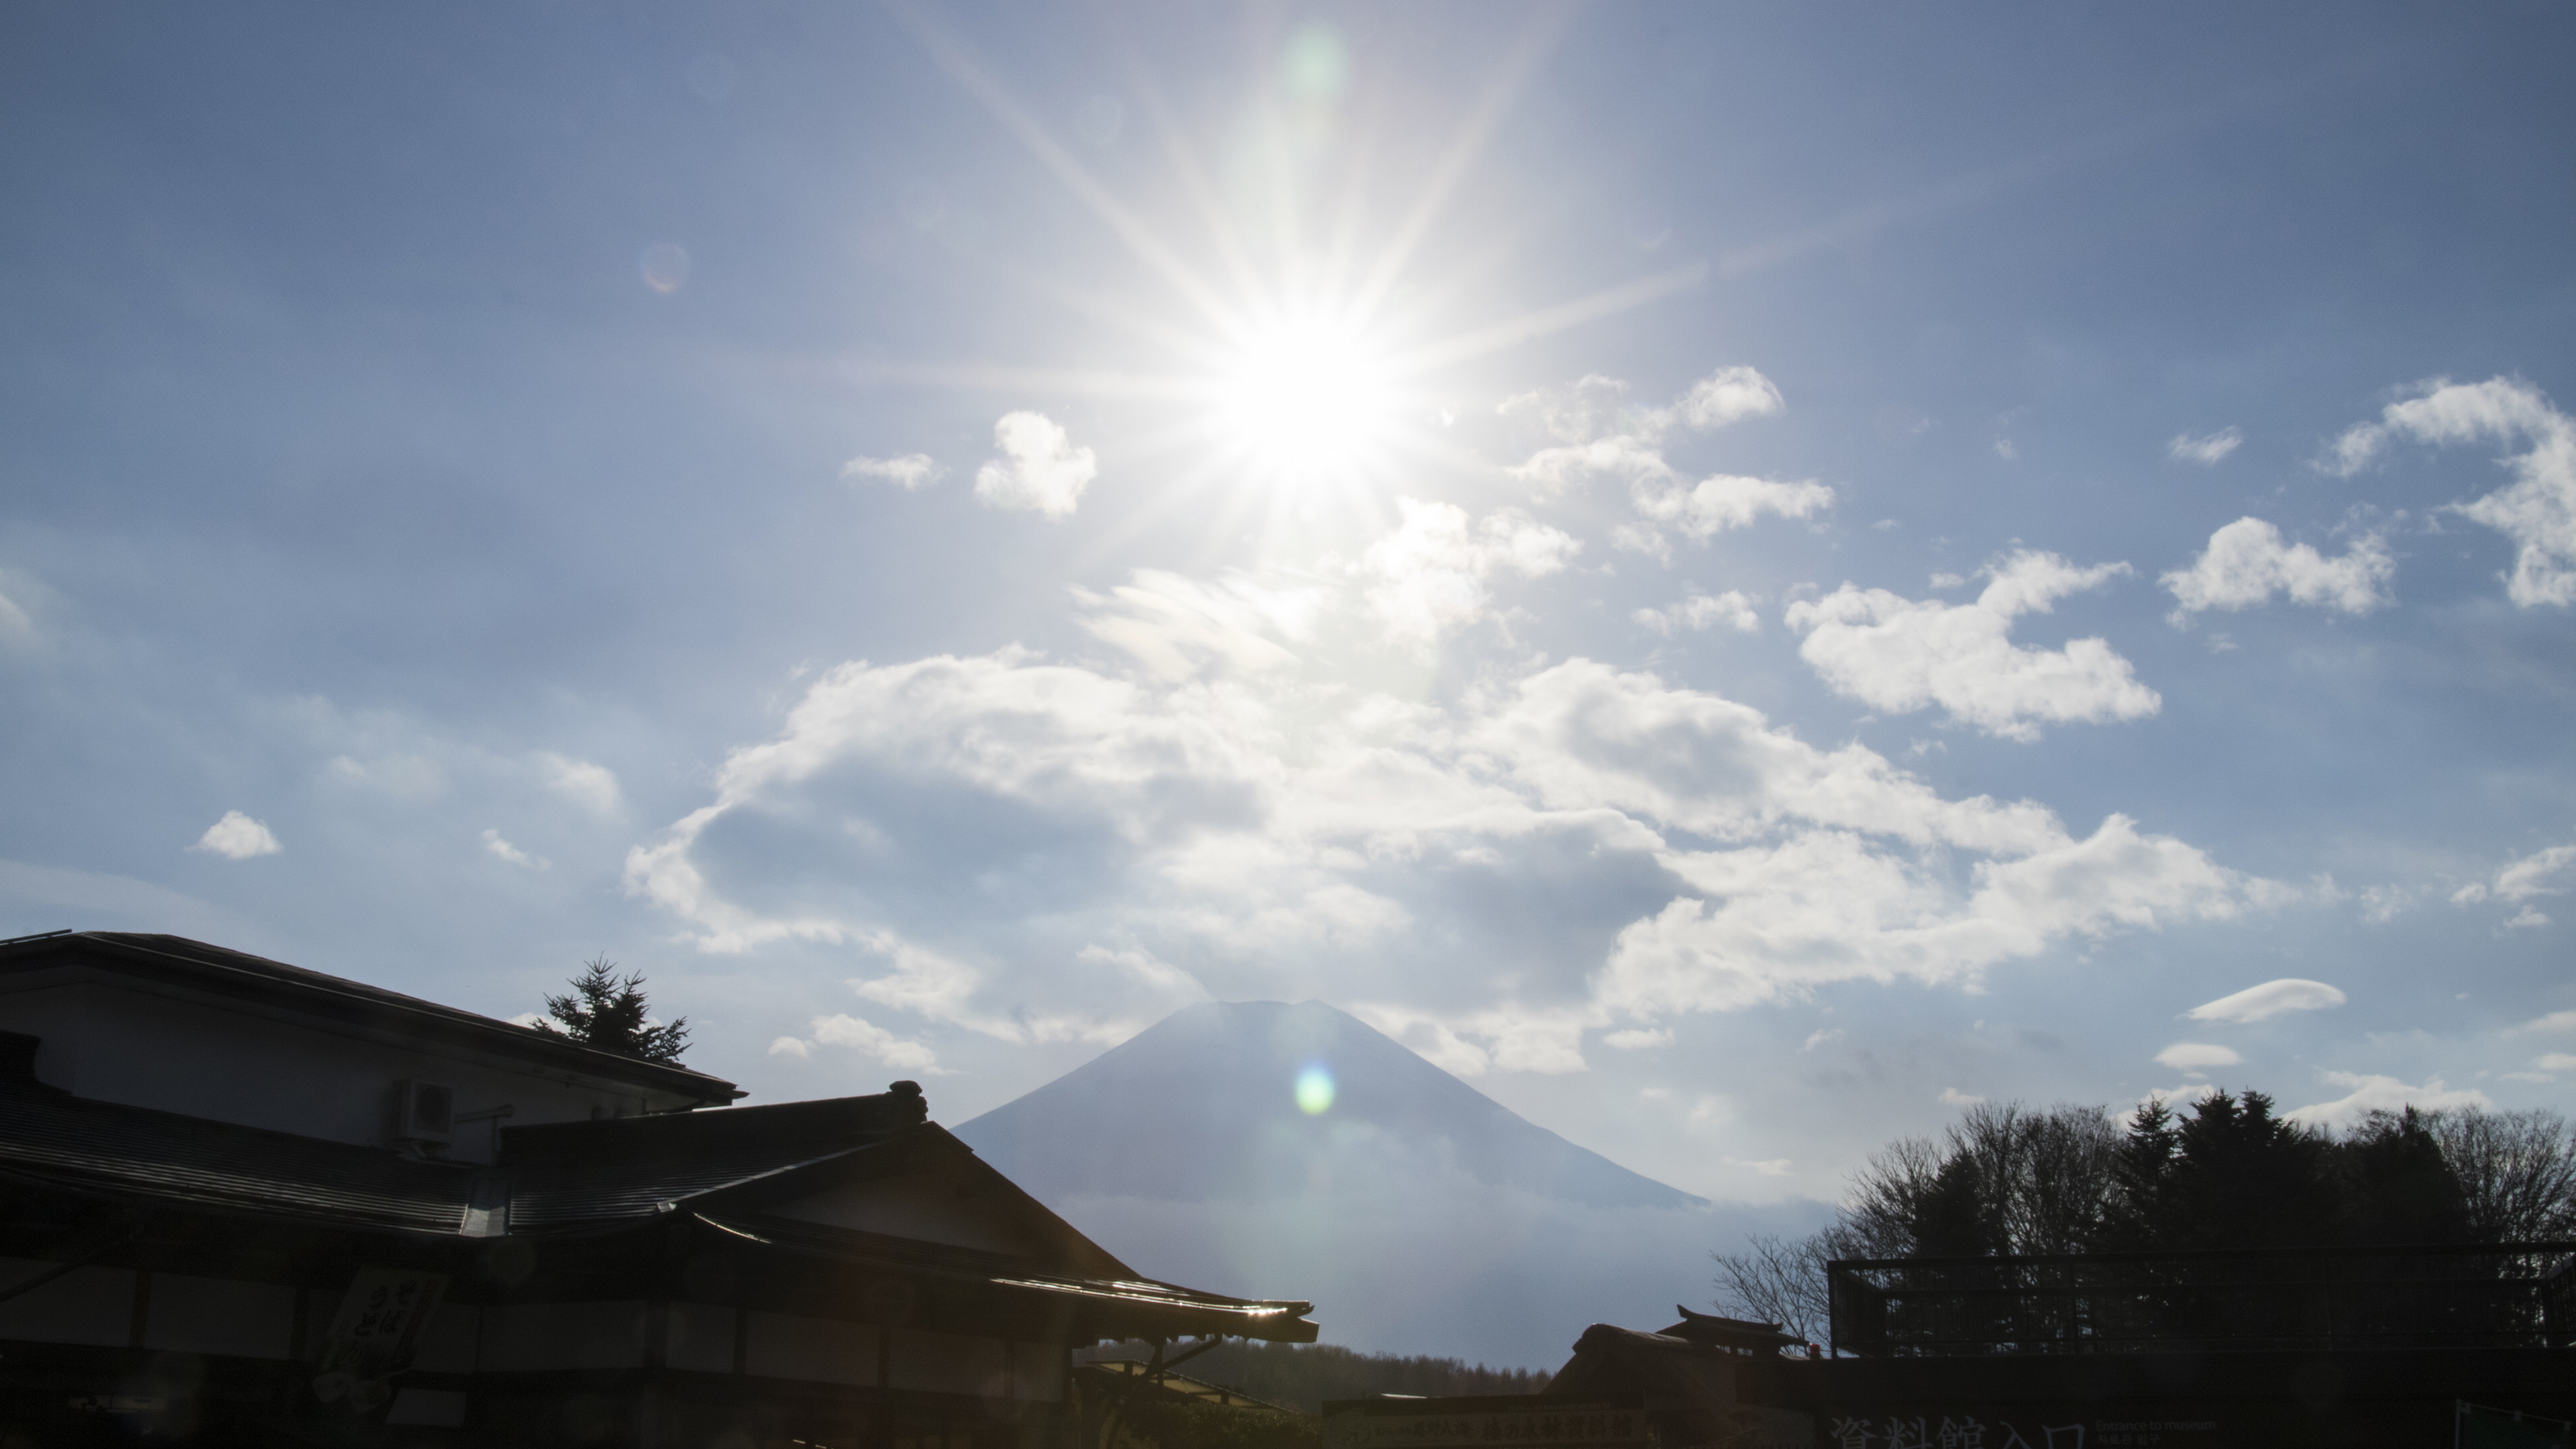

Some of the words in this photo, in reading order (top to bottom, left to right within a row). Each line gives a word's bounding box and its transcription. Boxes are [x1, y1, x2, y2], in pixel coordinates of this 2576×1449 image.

[379, 1279, 418, 1334] そば
[1830, 1415, 2086, 1449] 資料館入口
[2096, 1420, 2147, 1432] Entrance
[2149, 1421, 2162, 1431] to
[2164, 1421, 2217, 1430] museum
[2097, 1434, 2133, 1444] 자료관
[2137, 1433, 2160, 1445] 입구
